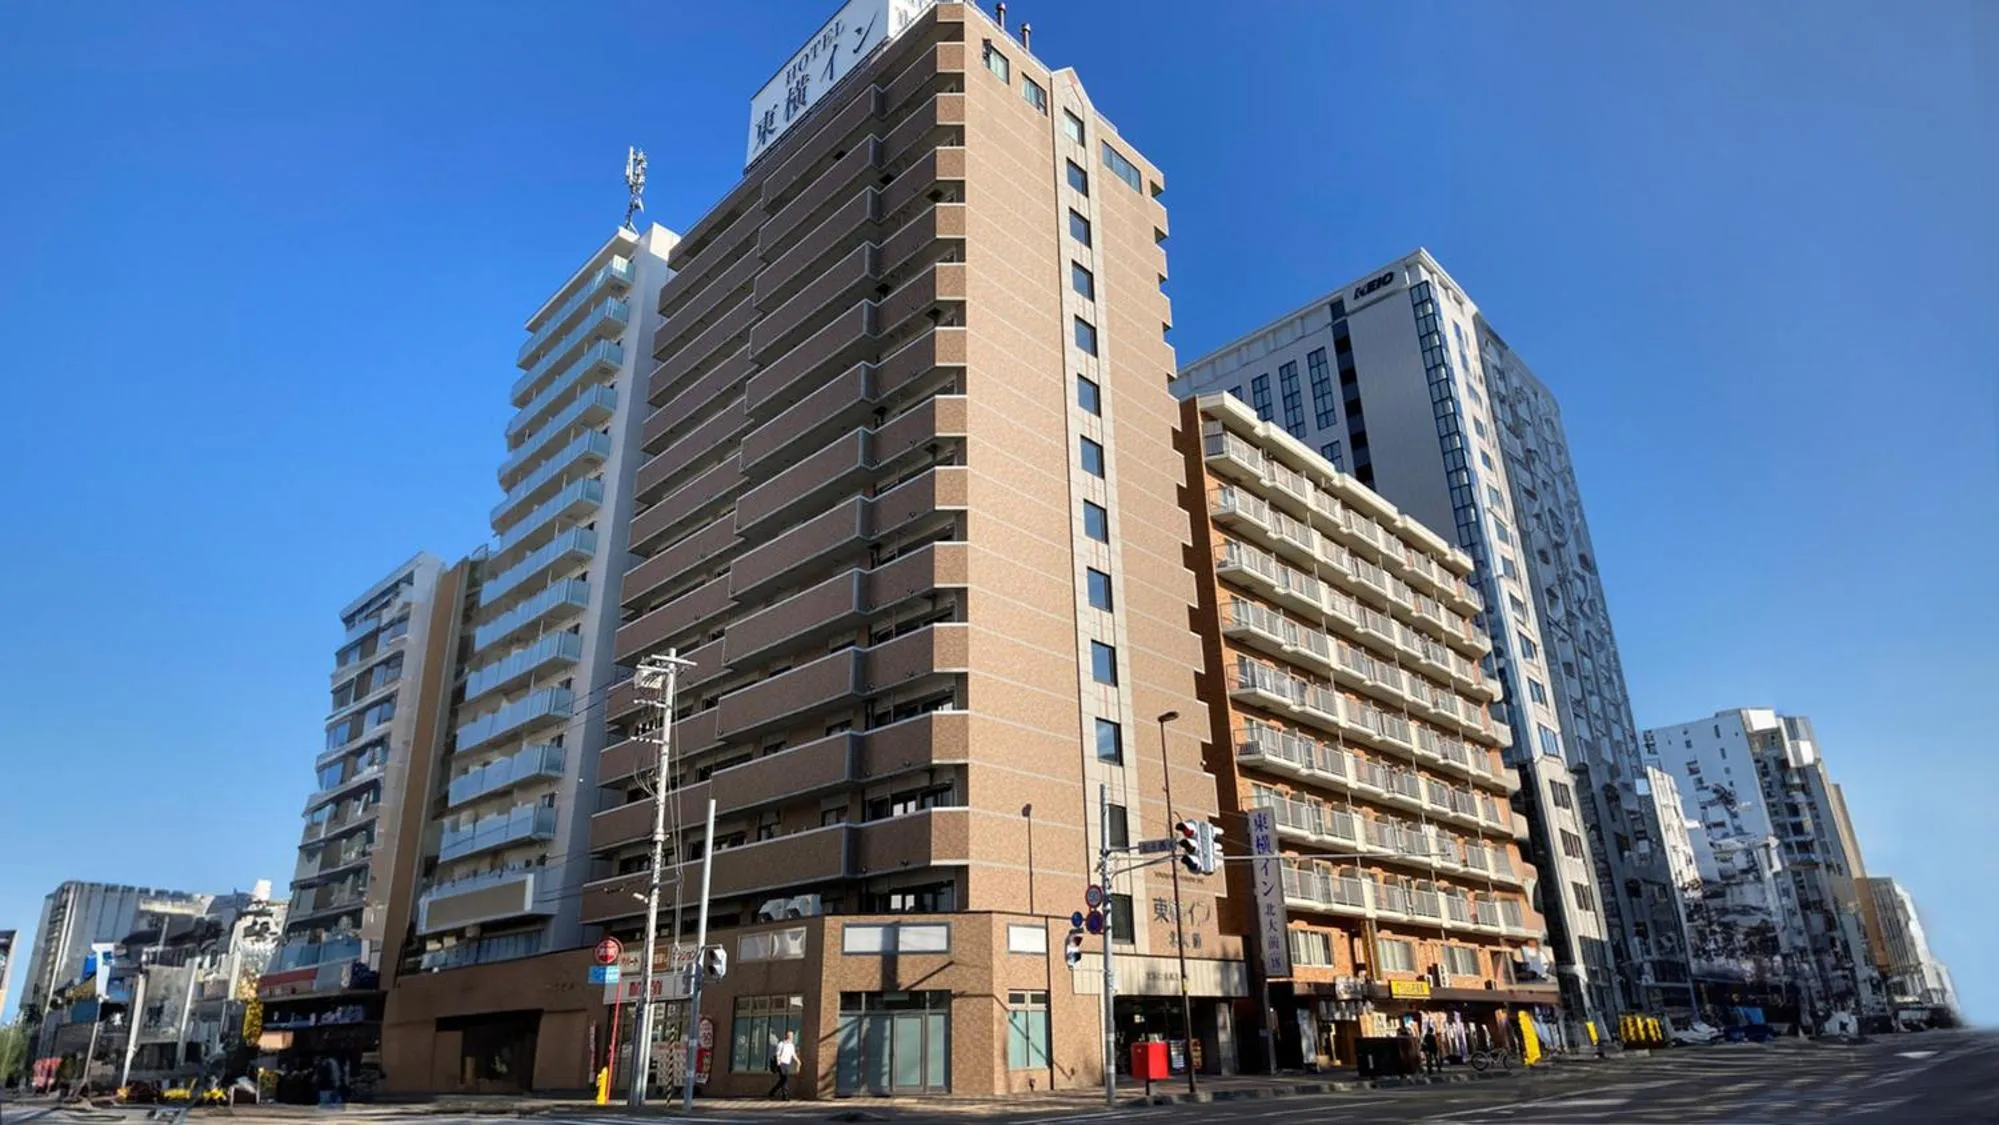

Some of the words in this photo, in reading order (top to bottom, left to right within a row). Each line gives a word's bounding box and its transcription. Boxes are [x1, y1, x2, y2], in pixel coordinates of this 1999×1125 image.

[754, 9, 879, 148] 東横イン
[785, 19, 846, 87] HOTEL
[1253, 812, 1275, 896] 東横イン
